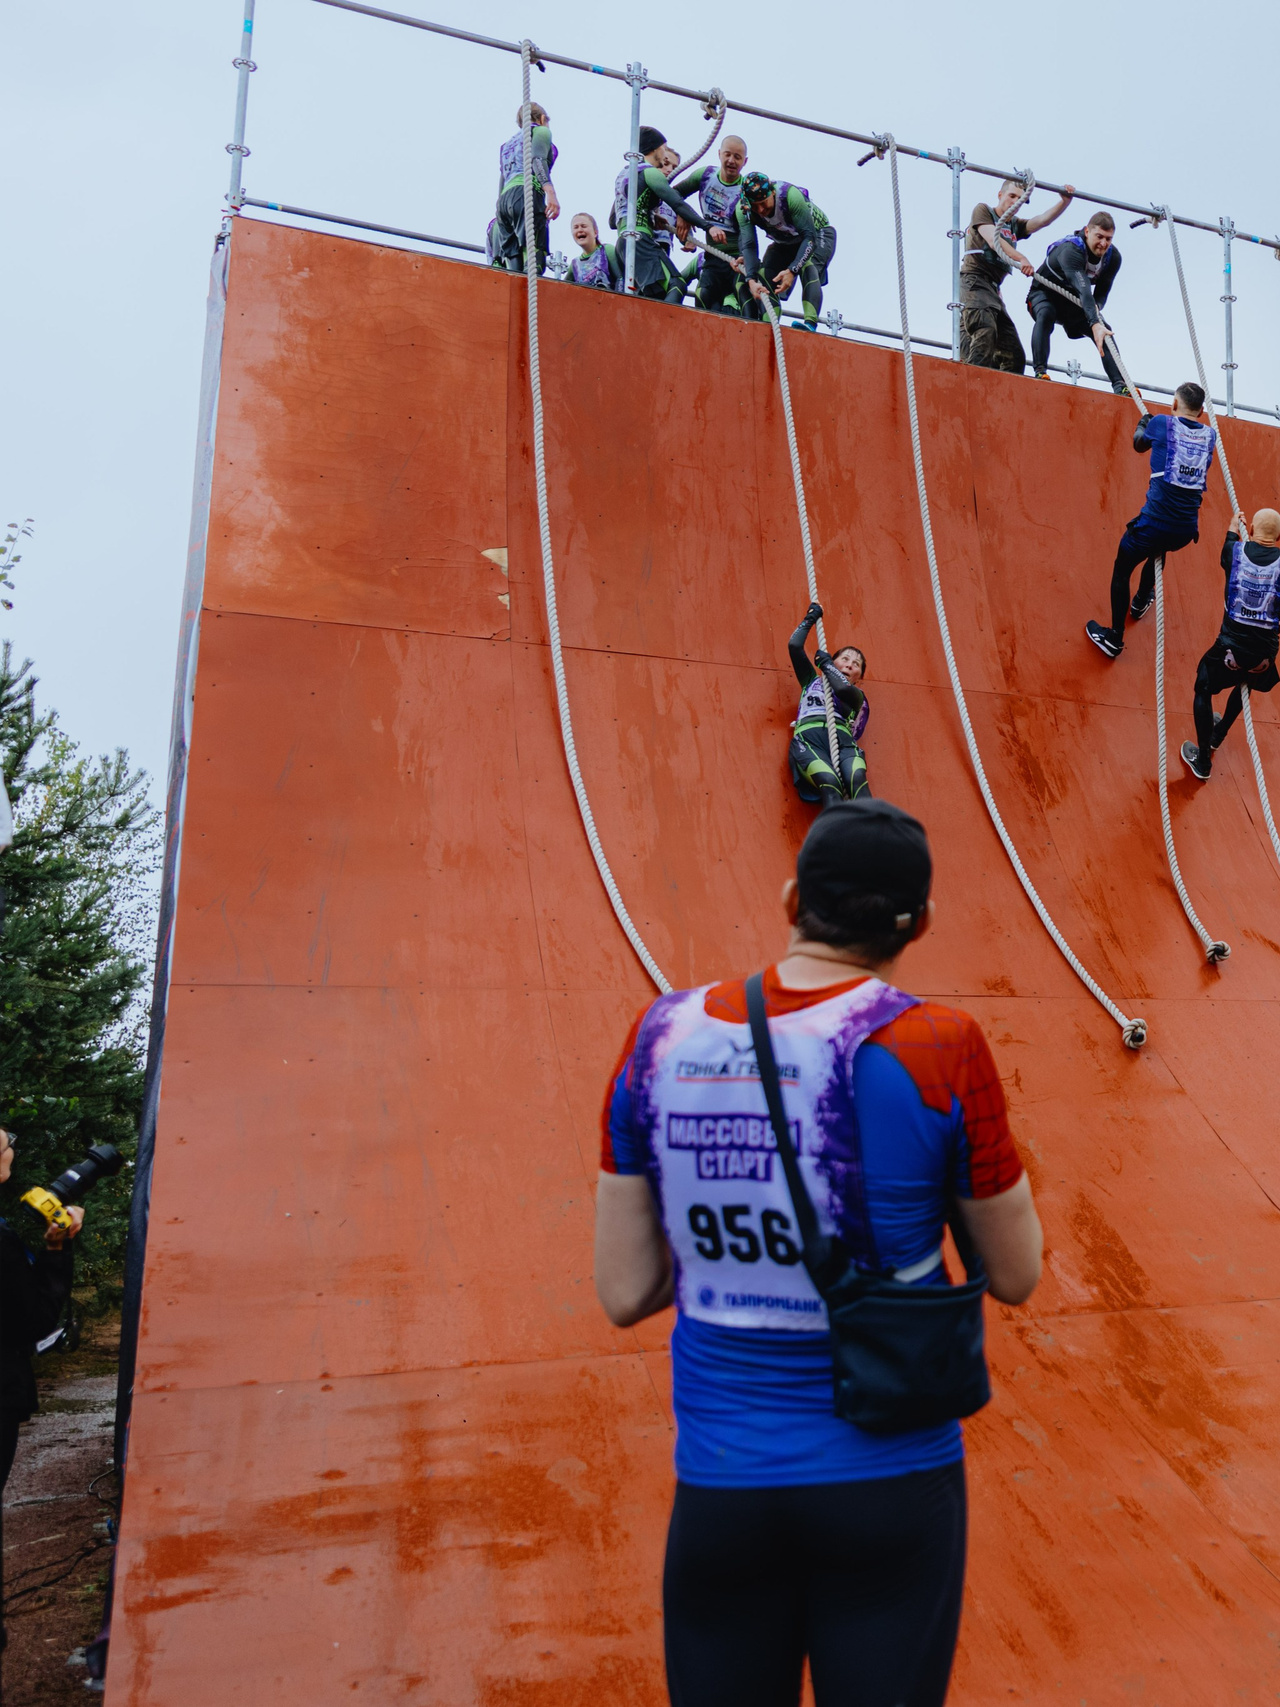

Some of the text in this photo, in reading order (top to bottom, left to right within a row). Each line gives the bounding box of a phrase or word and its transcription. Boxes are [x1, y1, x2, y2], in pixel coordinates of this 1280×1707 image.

[678, 1060, 800, 1079] ГОНКА ГЕЕВ
[669, 1116, 797, 1151] МАССОВЫ
[700, 1151, 769, 1181] СТАРТ
[688, 1204, 803, 1267] 956
